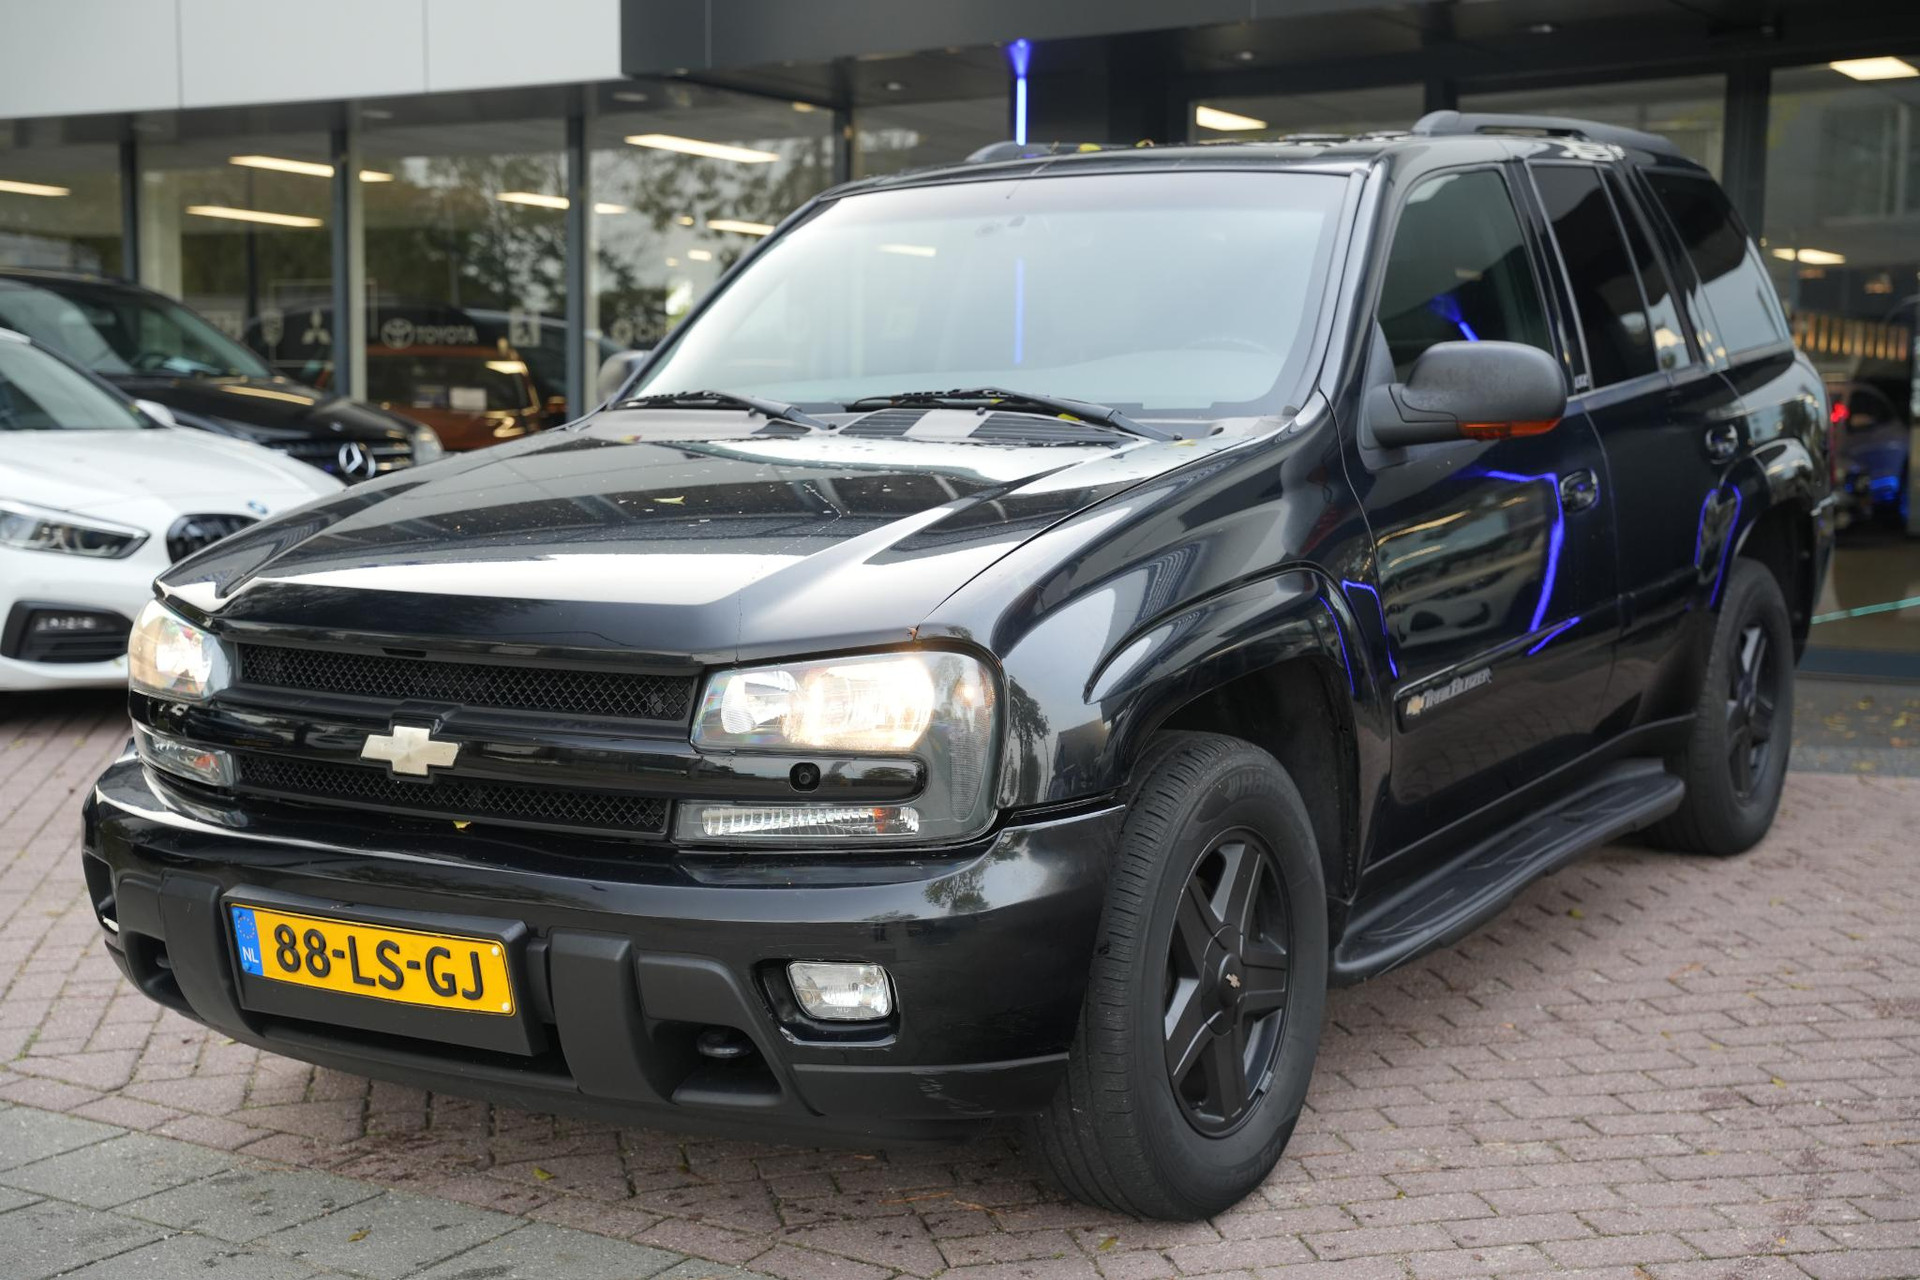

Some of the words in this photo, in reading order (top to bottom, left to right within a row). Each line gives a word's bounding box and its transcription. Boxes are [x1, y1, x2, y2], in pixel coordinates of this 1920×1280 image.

[416, 325, 479, 345] TOYOTA
[242, 946, 260, 964] NL
[273, 924, 484, 1001] 88-LS-GJ
